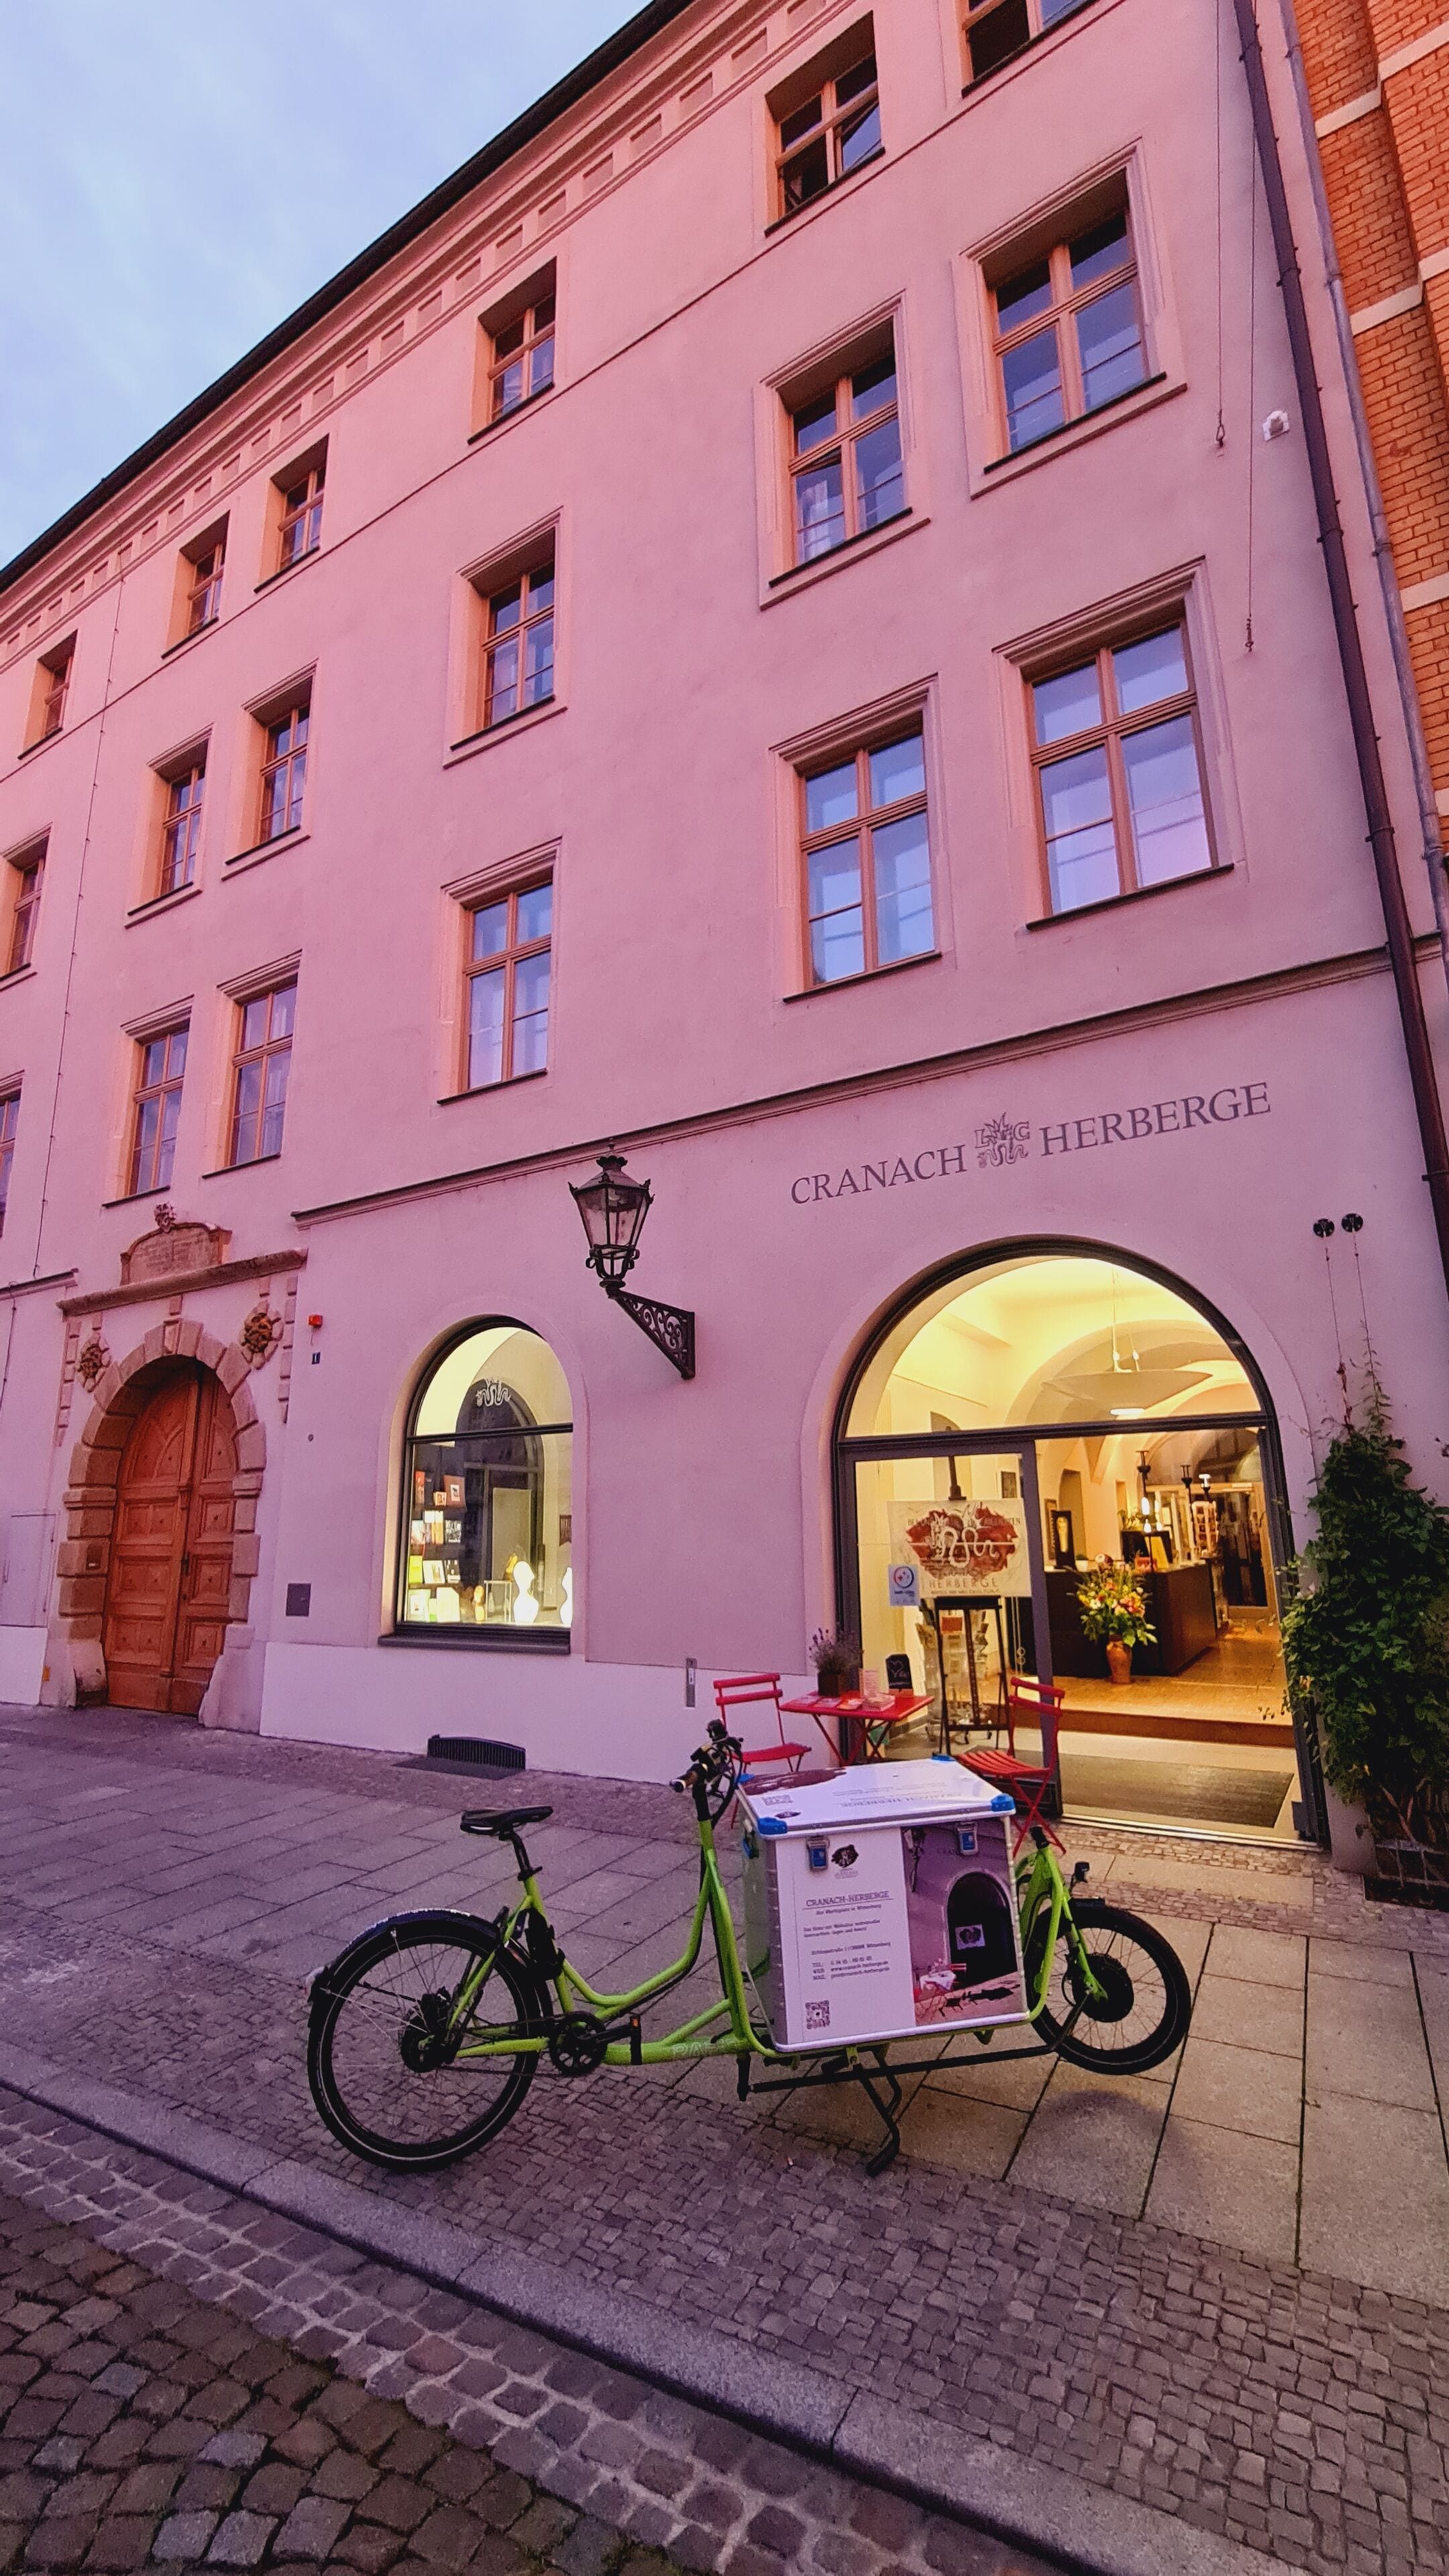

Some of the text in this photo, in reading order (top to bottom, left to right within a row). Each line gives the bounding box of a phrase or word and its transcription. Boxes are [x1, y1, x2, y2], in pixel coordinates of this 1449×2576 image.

[791, 1144, 968, 1205] CRANACH
[1039, 1081, 1272, 1157] HERBERGE
[806, 1890, 889, 1907] CRANACH-HERBERGE
